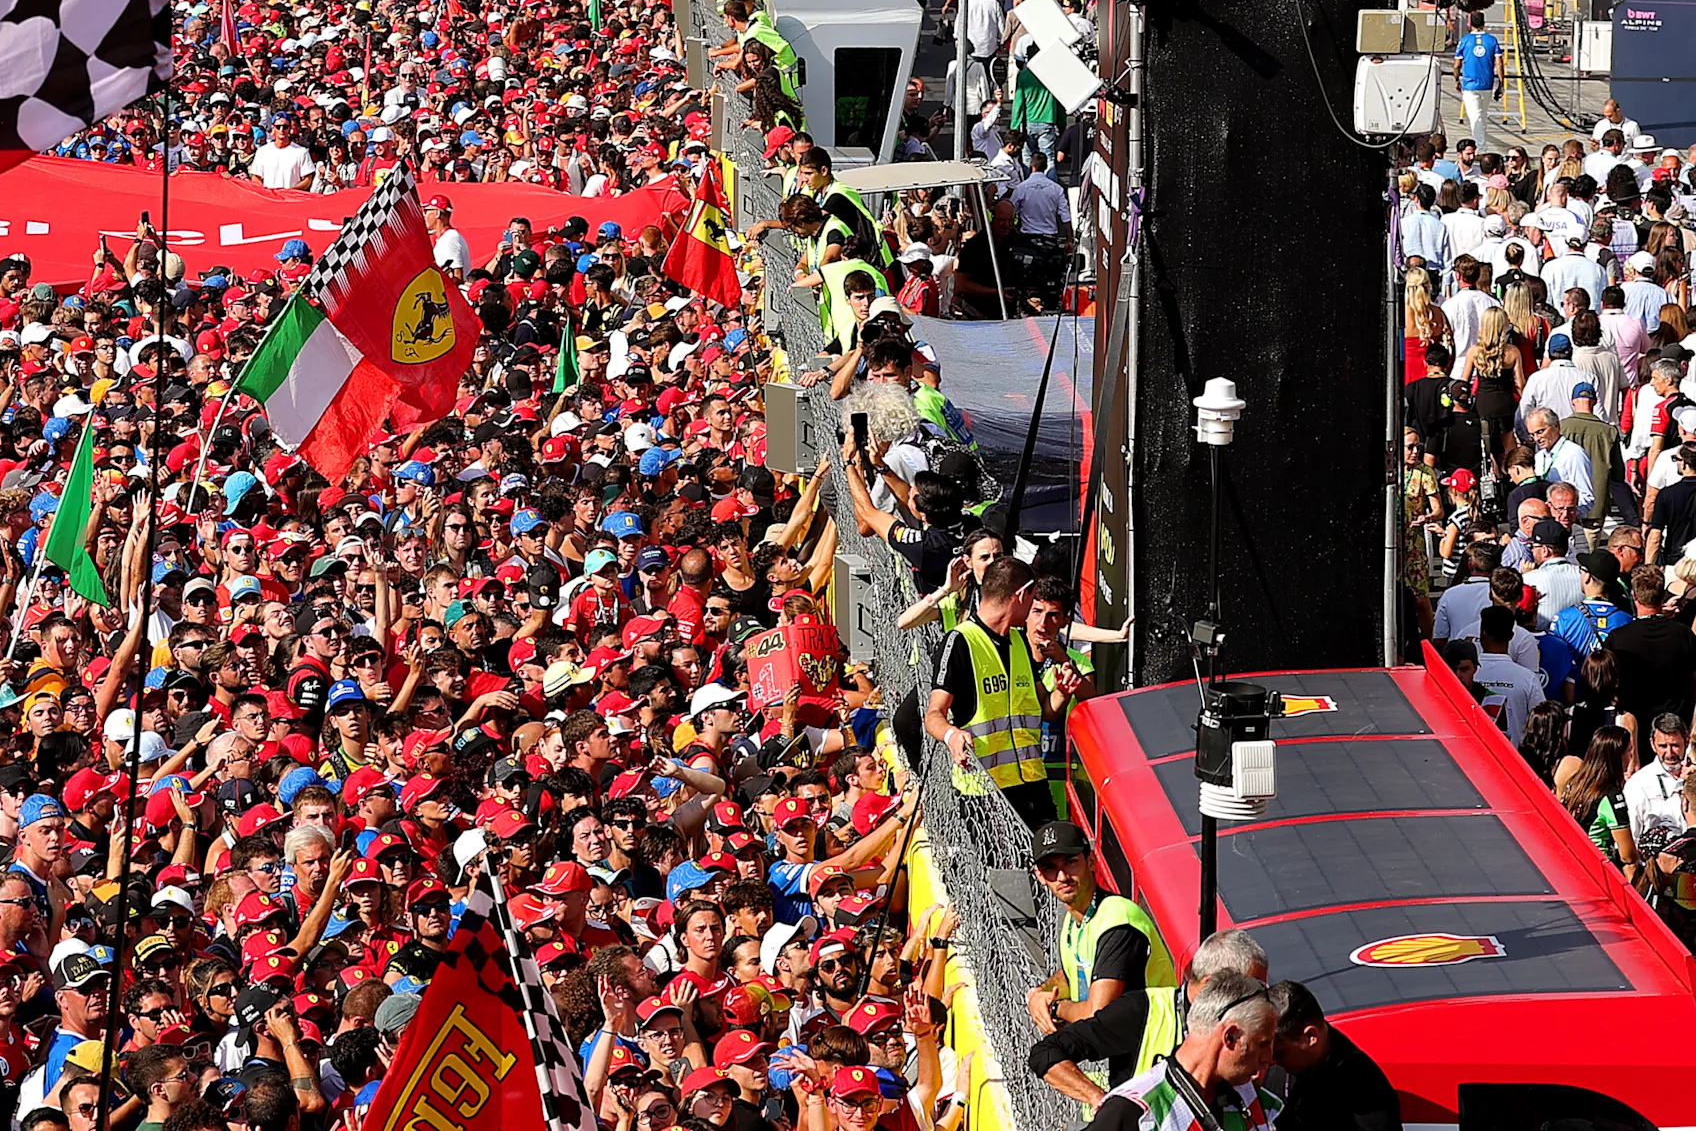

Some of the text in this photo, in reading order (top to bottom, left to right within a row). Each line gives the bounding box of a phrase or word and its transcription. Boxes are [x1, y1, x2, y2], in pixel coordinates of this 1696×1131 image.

[1621, 19, 1663, 27] ALPINE
[1636, 11, 1656, 19] BWT
[1545, 221, 1568, 230] VISA
[747, 631, 786, 658] #44
[798, 627, 839, 652] TRACK
[752, 662, 782, 704] #1
[983, 673, 1008, 695] 696
[1040, 734, 1061, 754] 67
